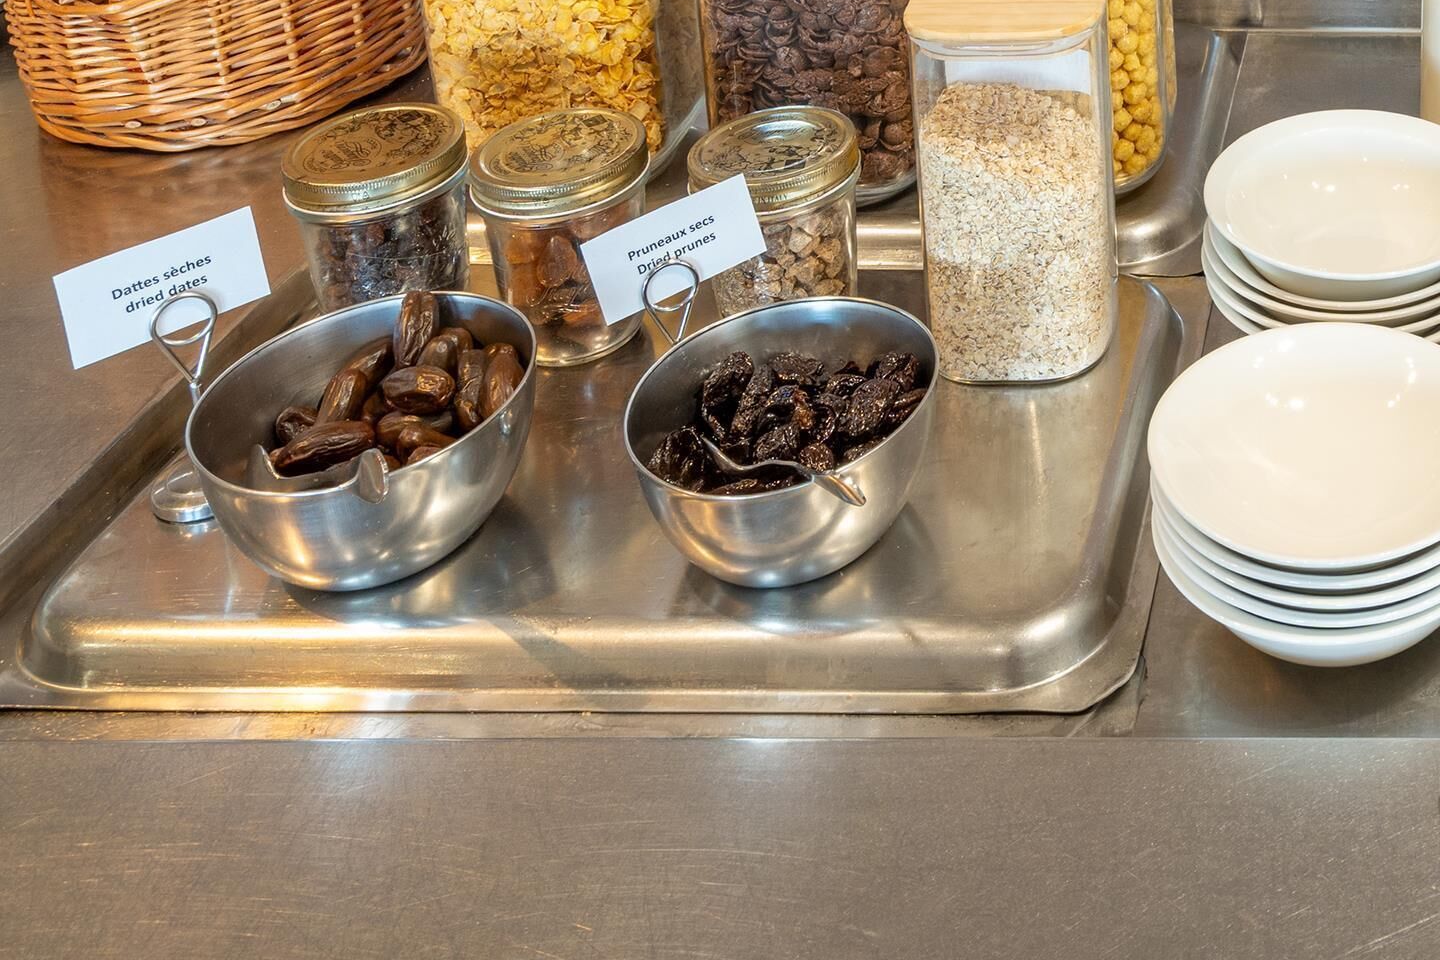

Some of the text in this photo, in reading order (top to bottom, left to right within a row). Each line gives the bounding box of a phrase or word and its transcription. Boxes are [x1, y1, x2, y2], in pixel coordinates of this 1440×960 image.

[627, 215, 715, 261] Pruneaux secs
[674, 232, 716, 259] prunes
[111, 255, 212, 300] Dattes sèches
[125, 275, 208, 313] dried dates
